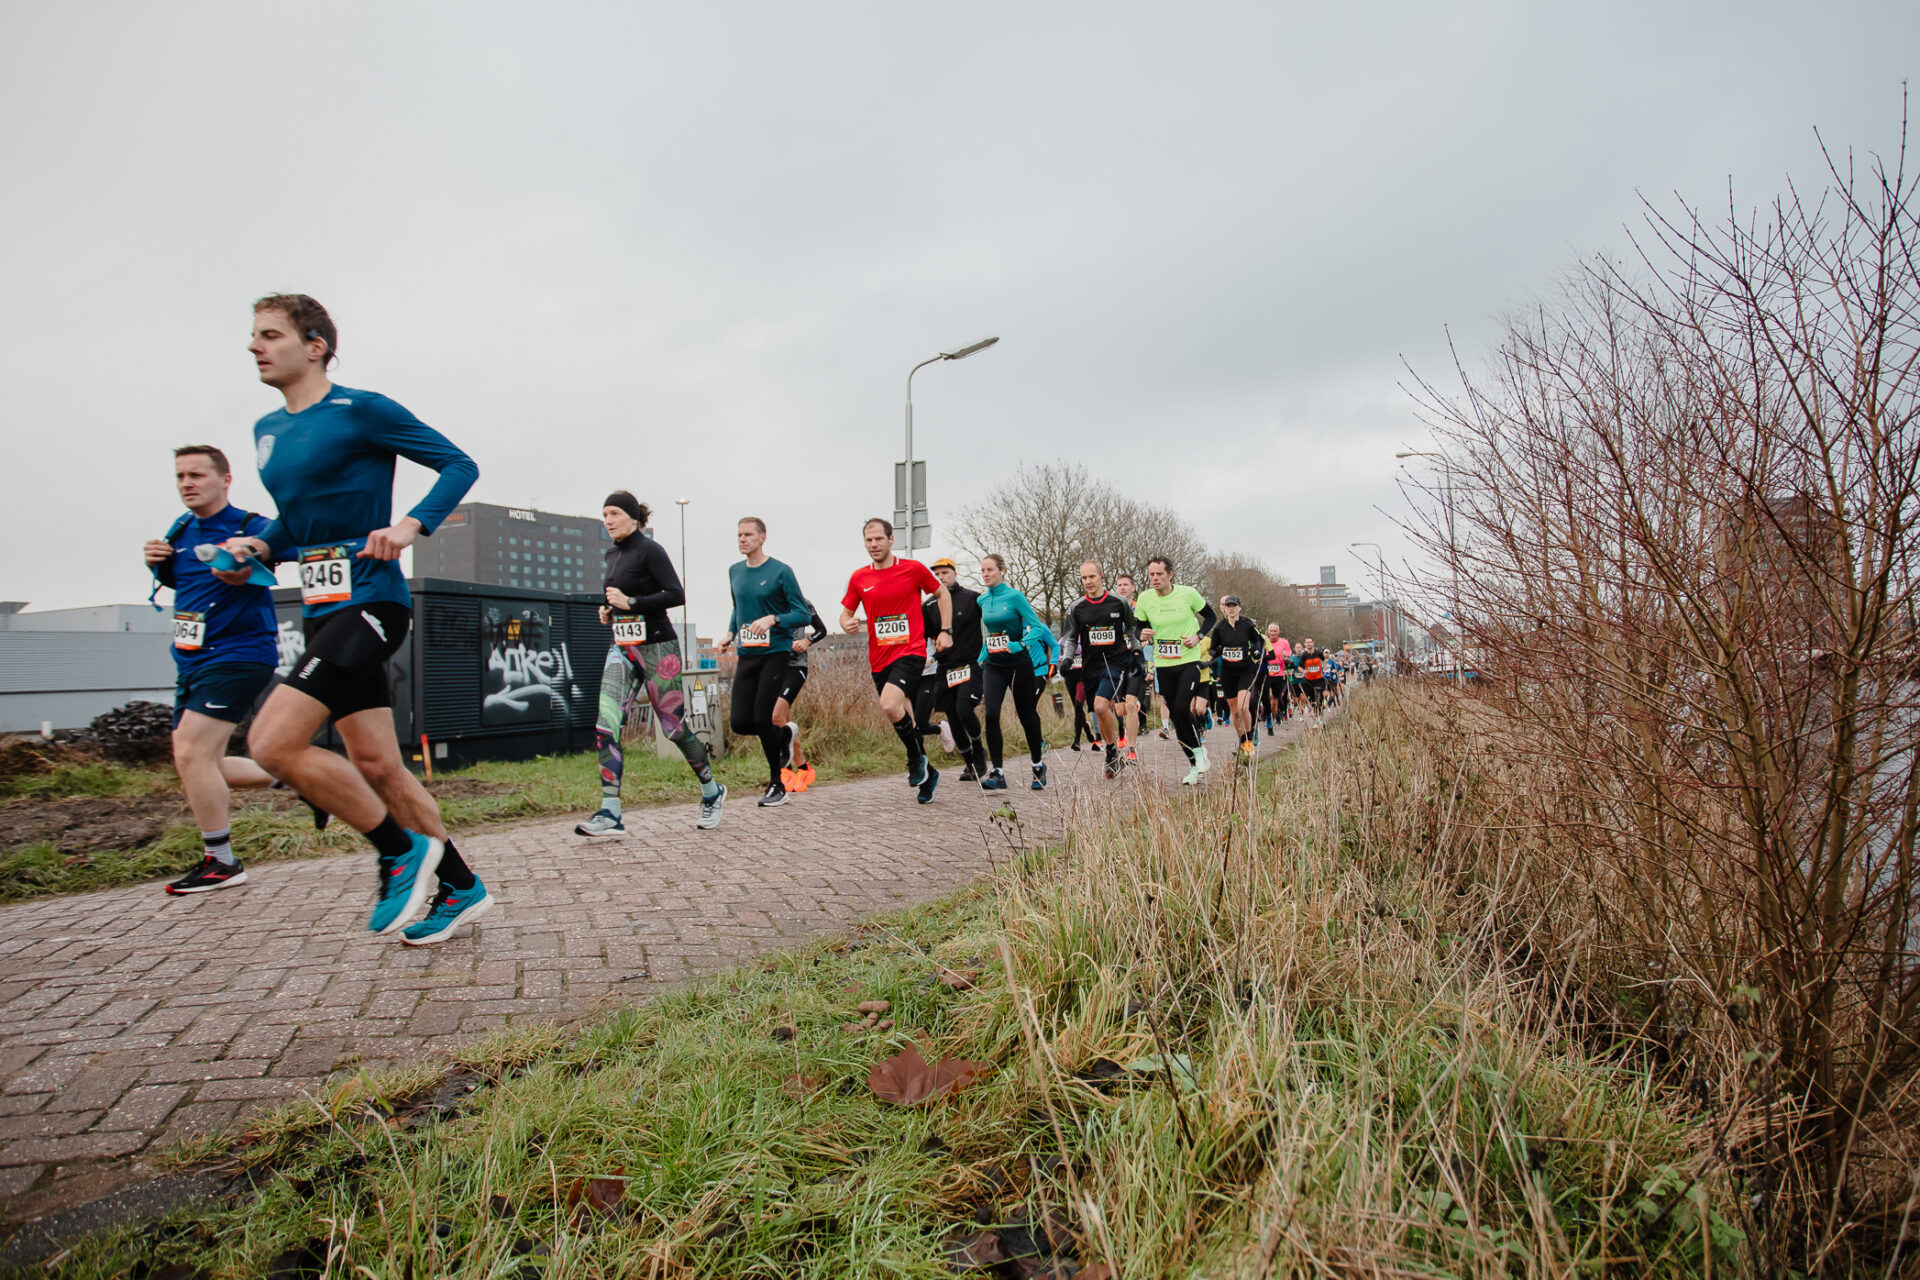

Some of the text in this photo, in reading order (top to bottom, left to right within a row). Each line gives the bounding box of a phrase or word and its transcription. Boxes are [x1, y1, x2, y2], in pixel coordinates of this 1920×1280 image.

[508, 509, 536, 521] HOTEL
[614, 623, 642, 637] 4143
[877, 621, 906, 634] 2206
[1091, 631, 1113, 640] 4098
[1158, 645, 1178, 654] 2311
[948, 669, 968, 681] 4131
